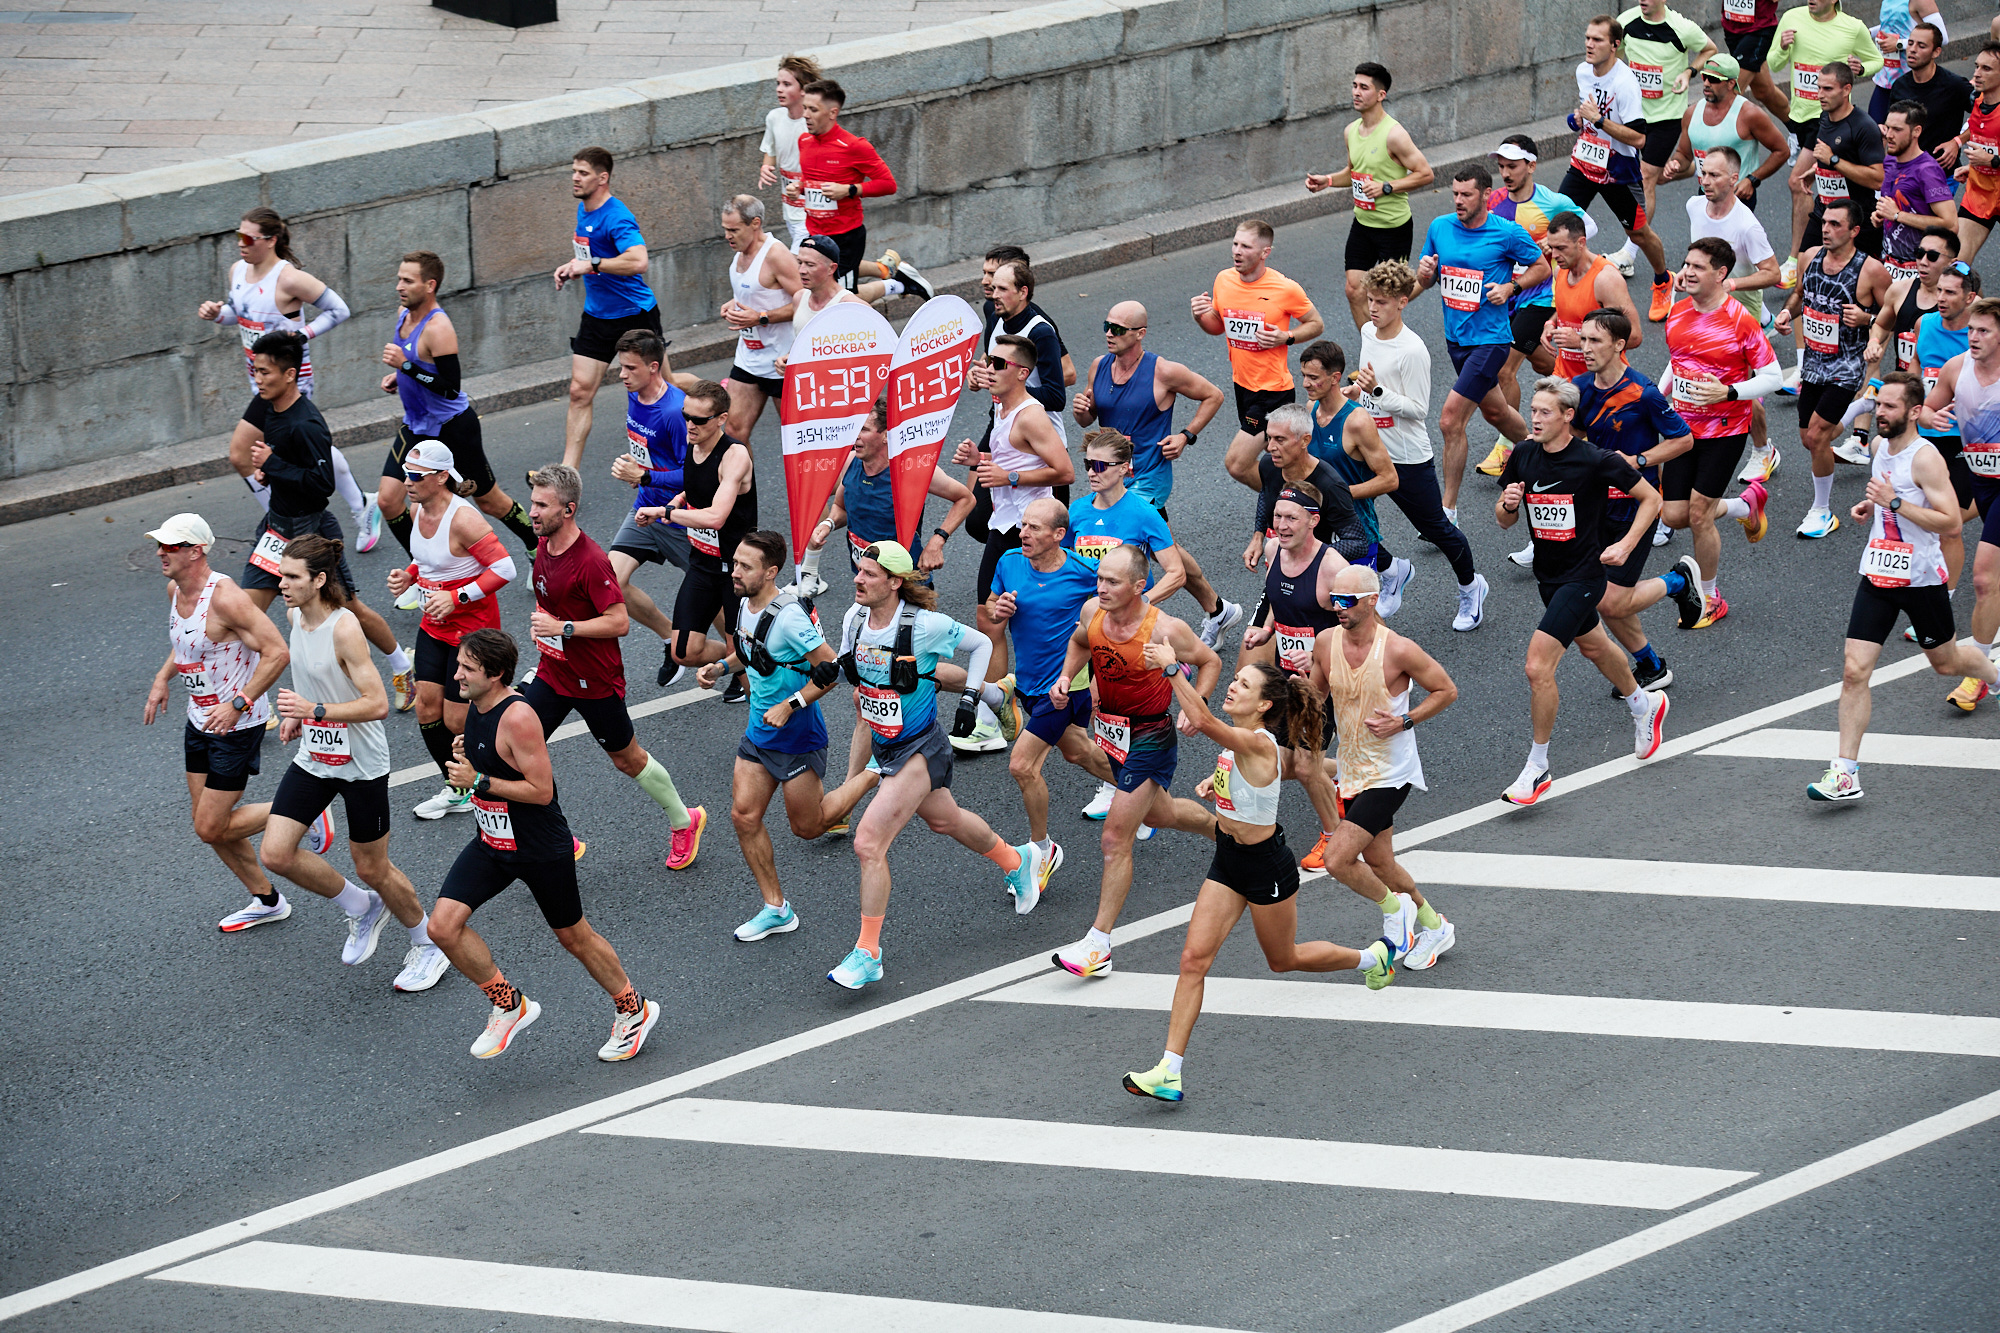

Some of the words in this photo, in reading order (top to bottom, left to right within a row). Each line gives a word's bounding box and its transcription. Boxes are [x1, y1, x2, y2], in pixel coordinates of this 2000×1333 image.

[1632, 70, 1662, 85] 5575
[1799, 72, 1819, 85] 102
[1581, 142, 1605, 160] 9718
[1817, 176, 1846, 191] 13454
[1442, 277, 1480, 294] 11400
[910, 317, 963, 346] МАРАФОН
[1229, 320, 1259, 334] 2977
[1806, 319, 1833, 337] 5559
[812, 330, 876, 346] МАРАФОН
[911, 332, 956, 357] МОСКВА
[812, 342, 866, 357] МОСКВА
[1900, 341, 1913, 356] 11
[795, 365, 870, 411] 0:39
[897, 354, 963, 412] 0:39
[1674, 378, 1691, 395] 165
[796, 428, 823, 445] 3:54
[899, 424, 923, 446] 3:54
[798, 460, 812, 473] 10
[1534, 506, 1567, 522] 8299
[1537, 530, 1542, 538] B
[263, 536, 283, 556] 186
[253, 556, 263, 565] B
[1870, 551, 1909, 570] 11025
[860, 696, 899, 717] 25589
[309, 728, 343, 746] 2904
[1095, 717, 1124, 741] 7369
[1096, 737, 1102, 746] B
[474, 806, 508, 830] 13117
